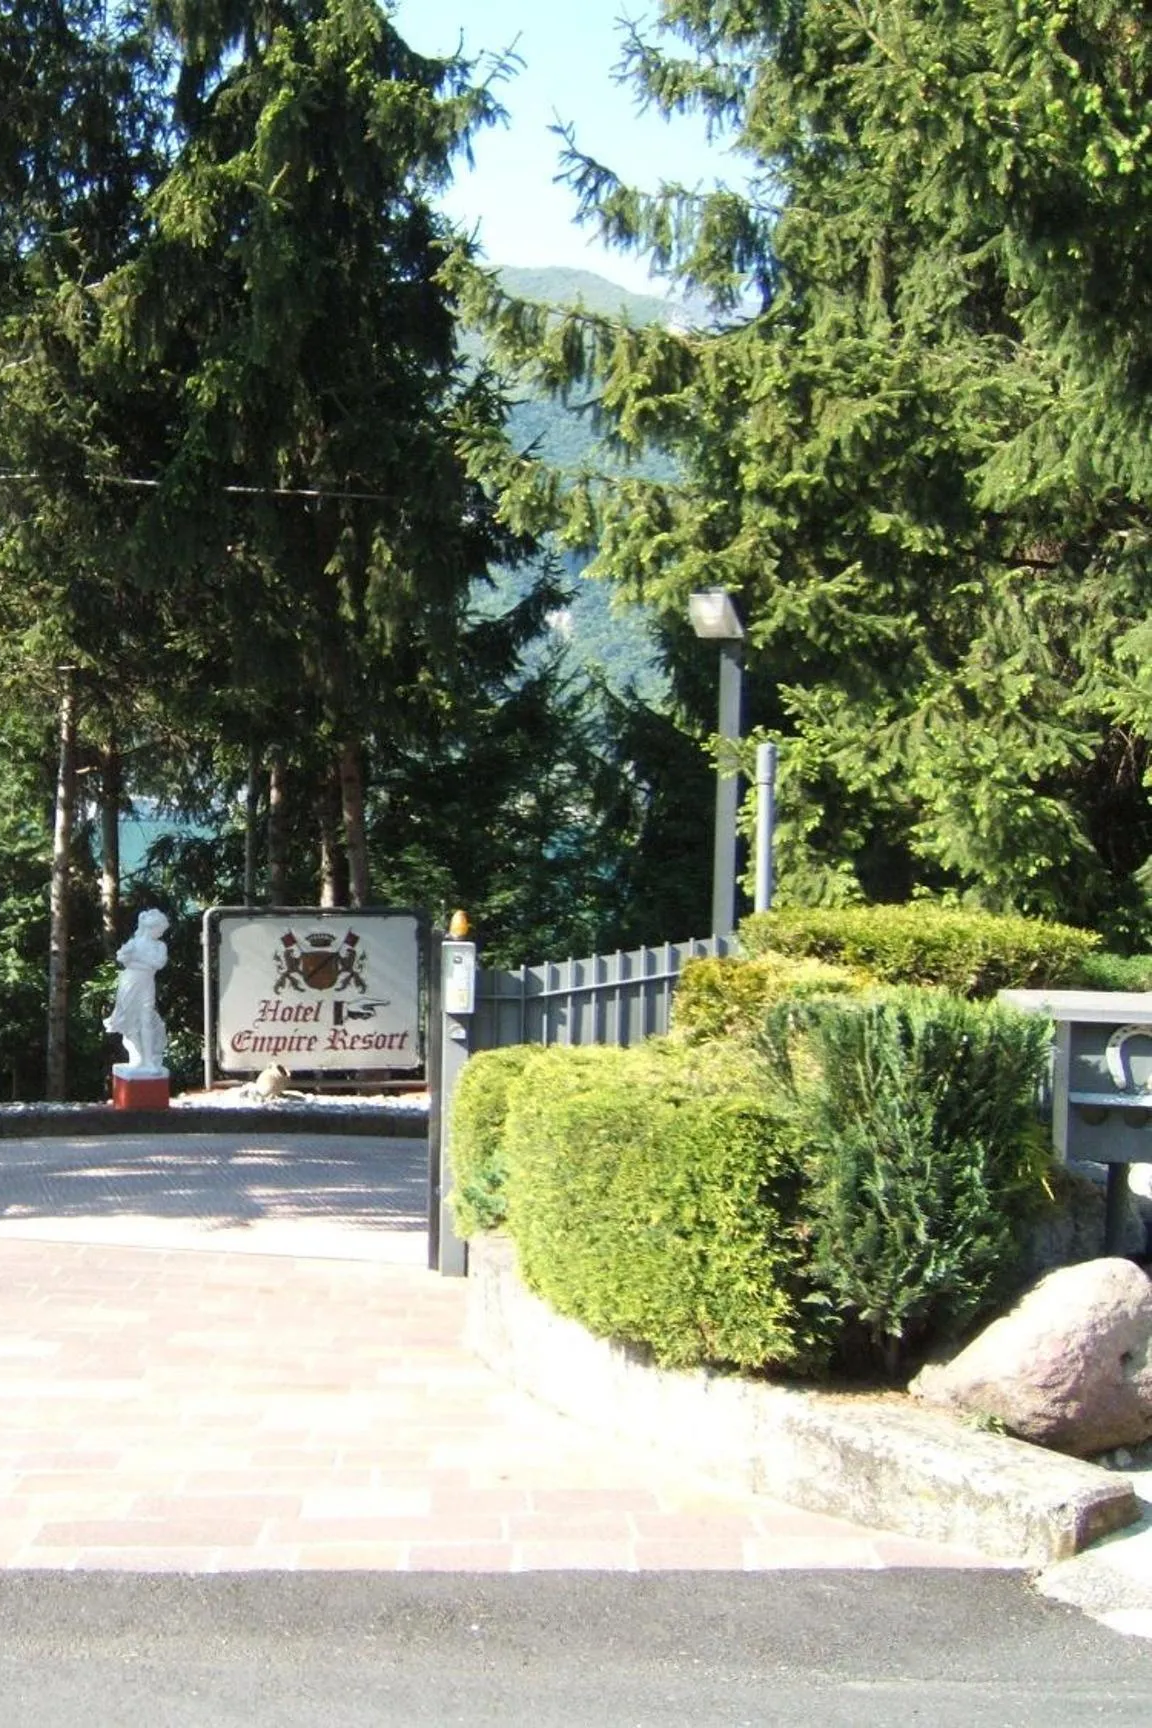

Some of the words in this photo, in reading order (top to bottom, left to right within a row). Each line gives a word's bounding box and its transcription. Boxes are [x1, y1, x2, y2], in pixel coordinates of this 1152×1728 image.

[253, 1000, 322, 1029] Hotel
[231, 1029, 318, 1053] Empire
[324, 1028, 409, 1051] Resort
